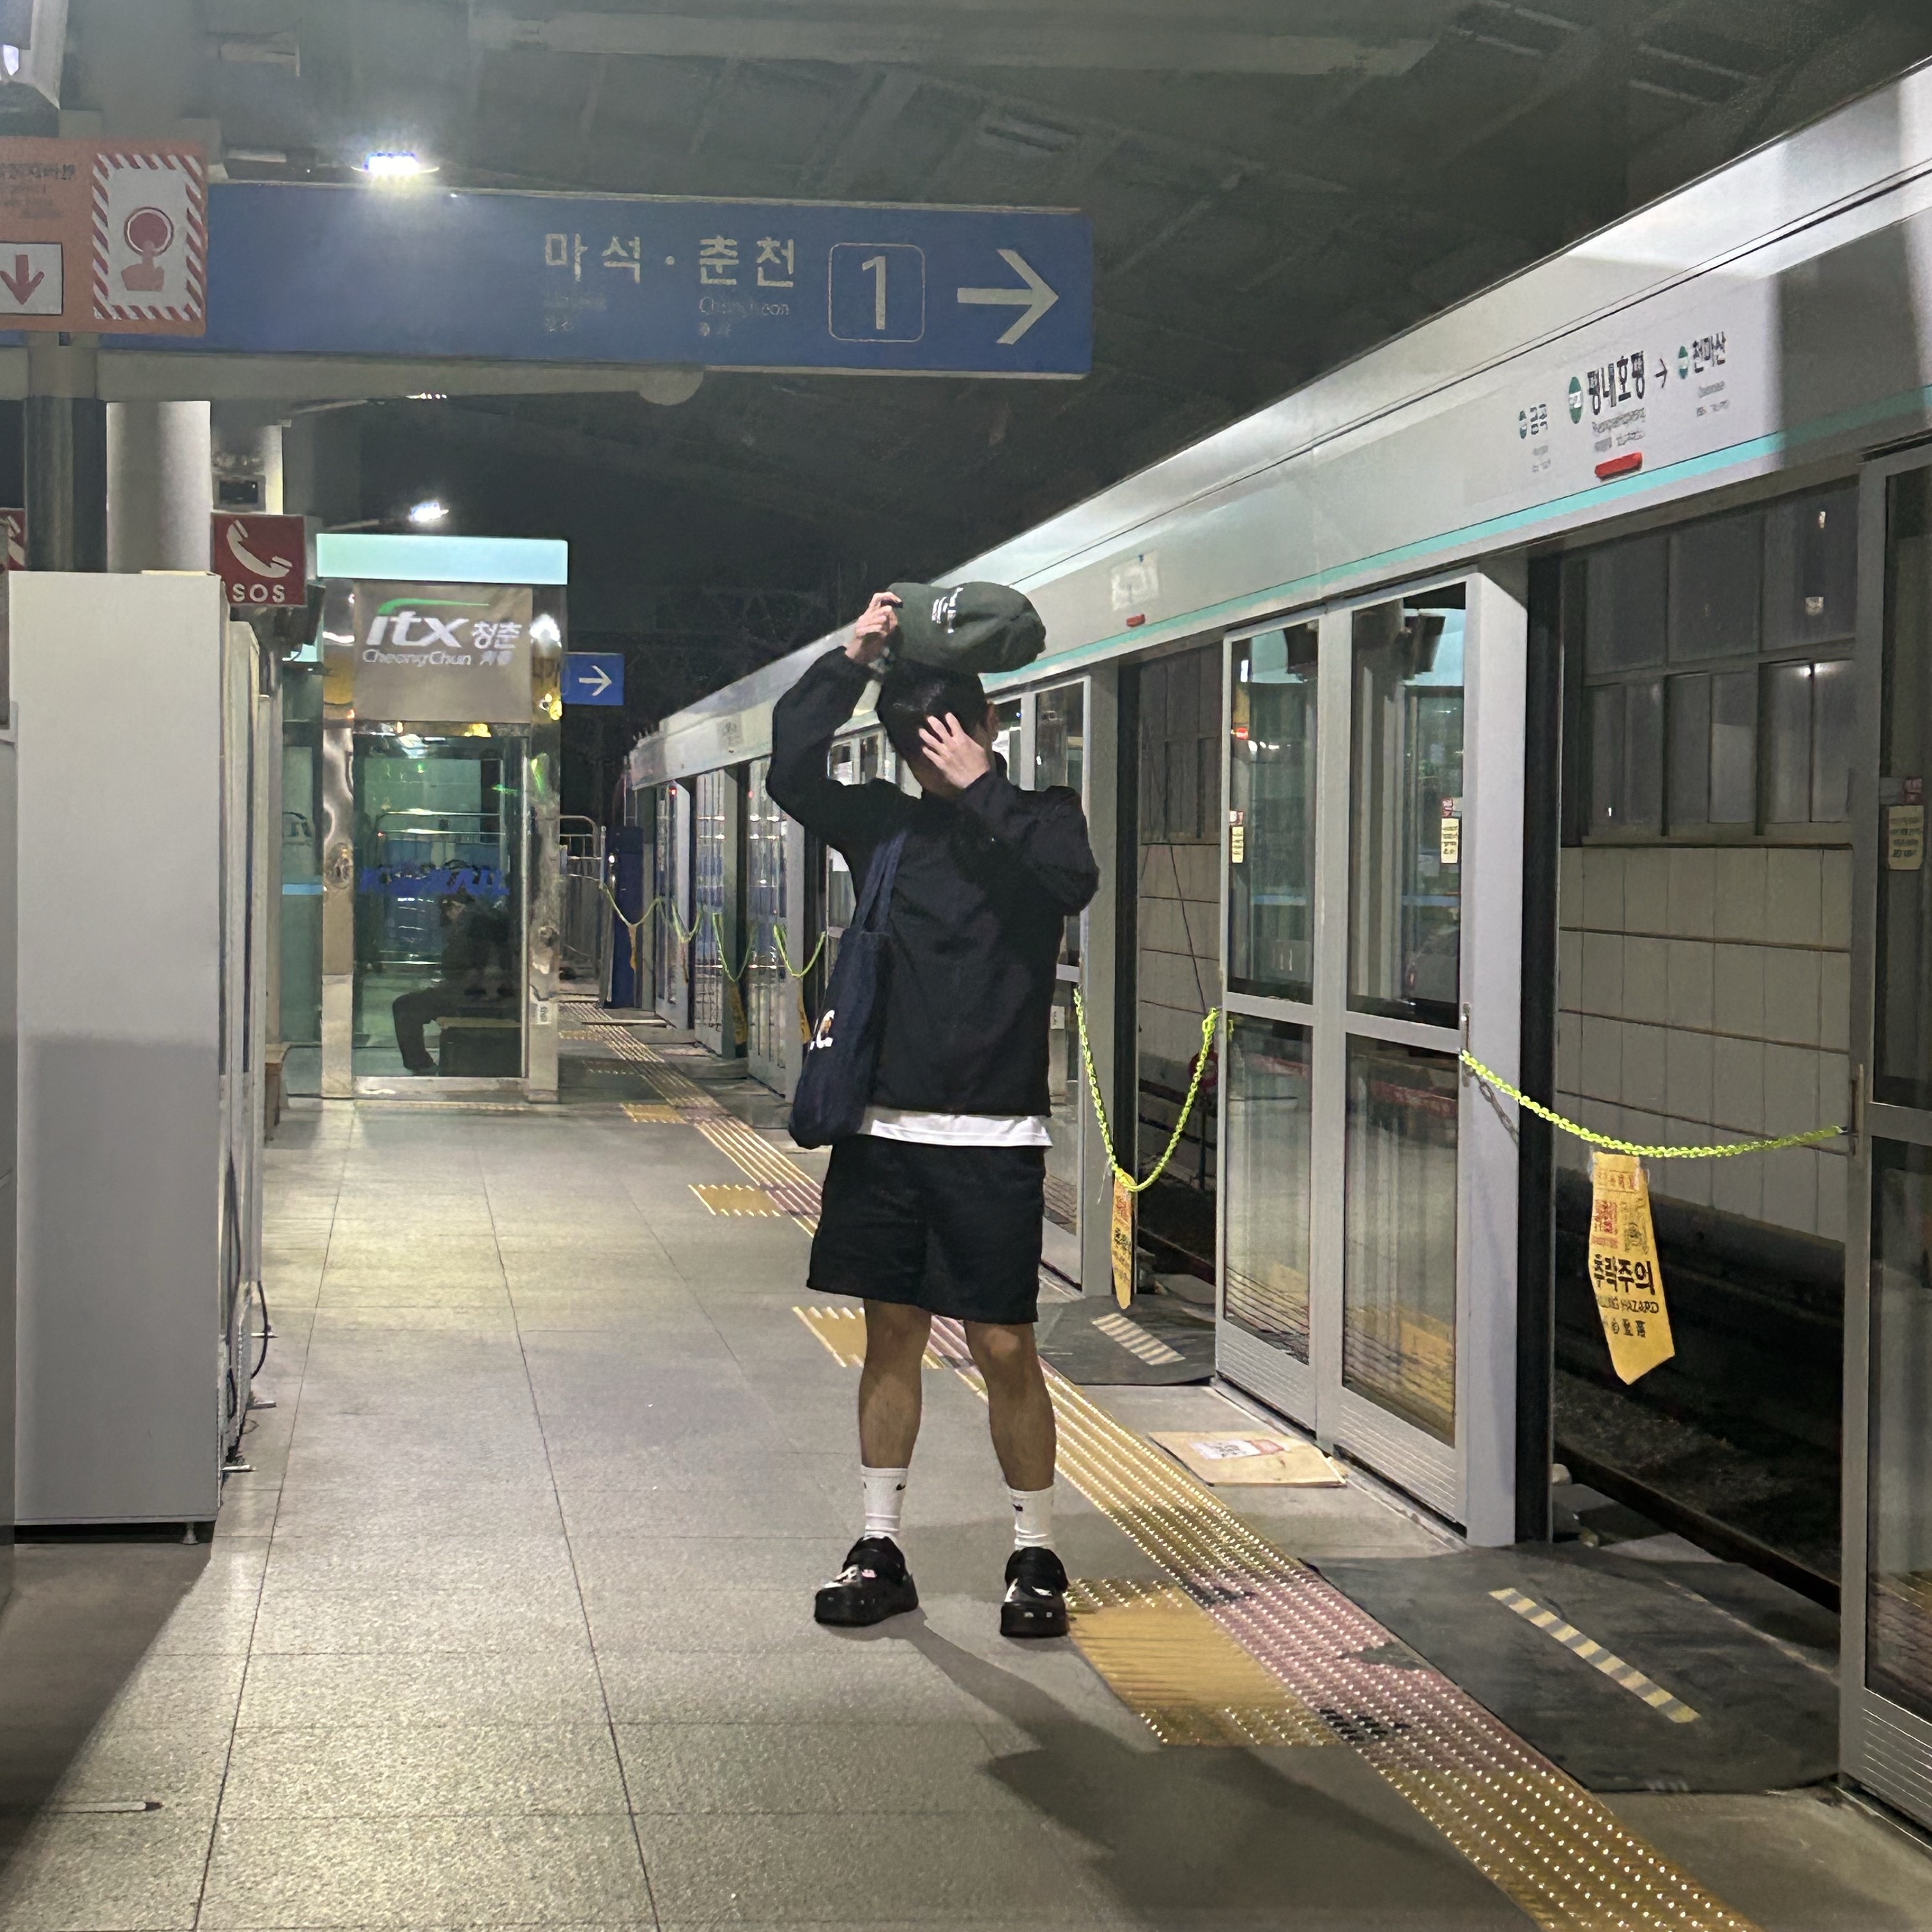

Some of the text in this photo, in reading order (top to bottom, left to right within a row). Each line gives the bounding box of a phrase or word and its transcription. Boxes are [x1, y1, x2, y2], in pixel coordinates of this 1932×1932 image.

[699, 234, 795, 288] 춘천
[862, 255, 886, 330] 1
[232, 584, 286, 603] SOS
[471, 621, 523, 650] 청춘
